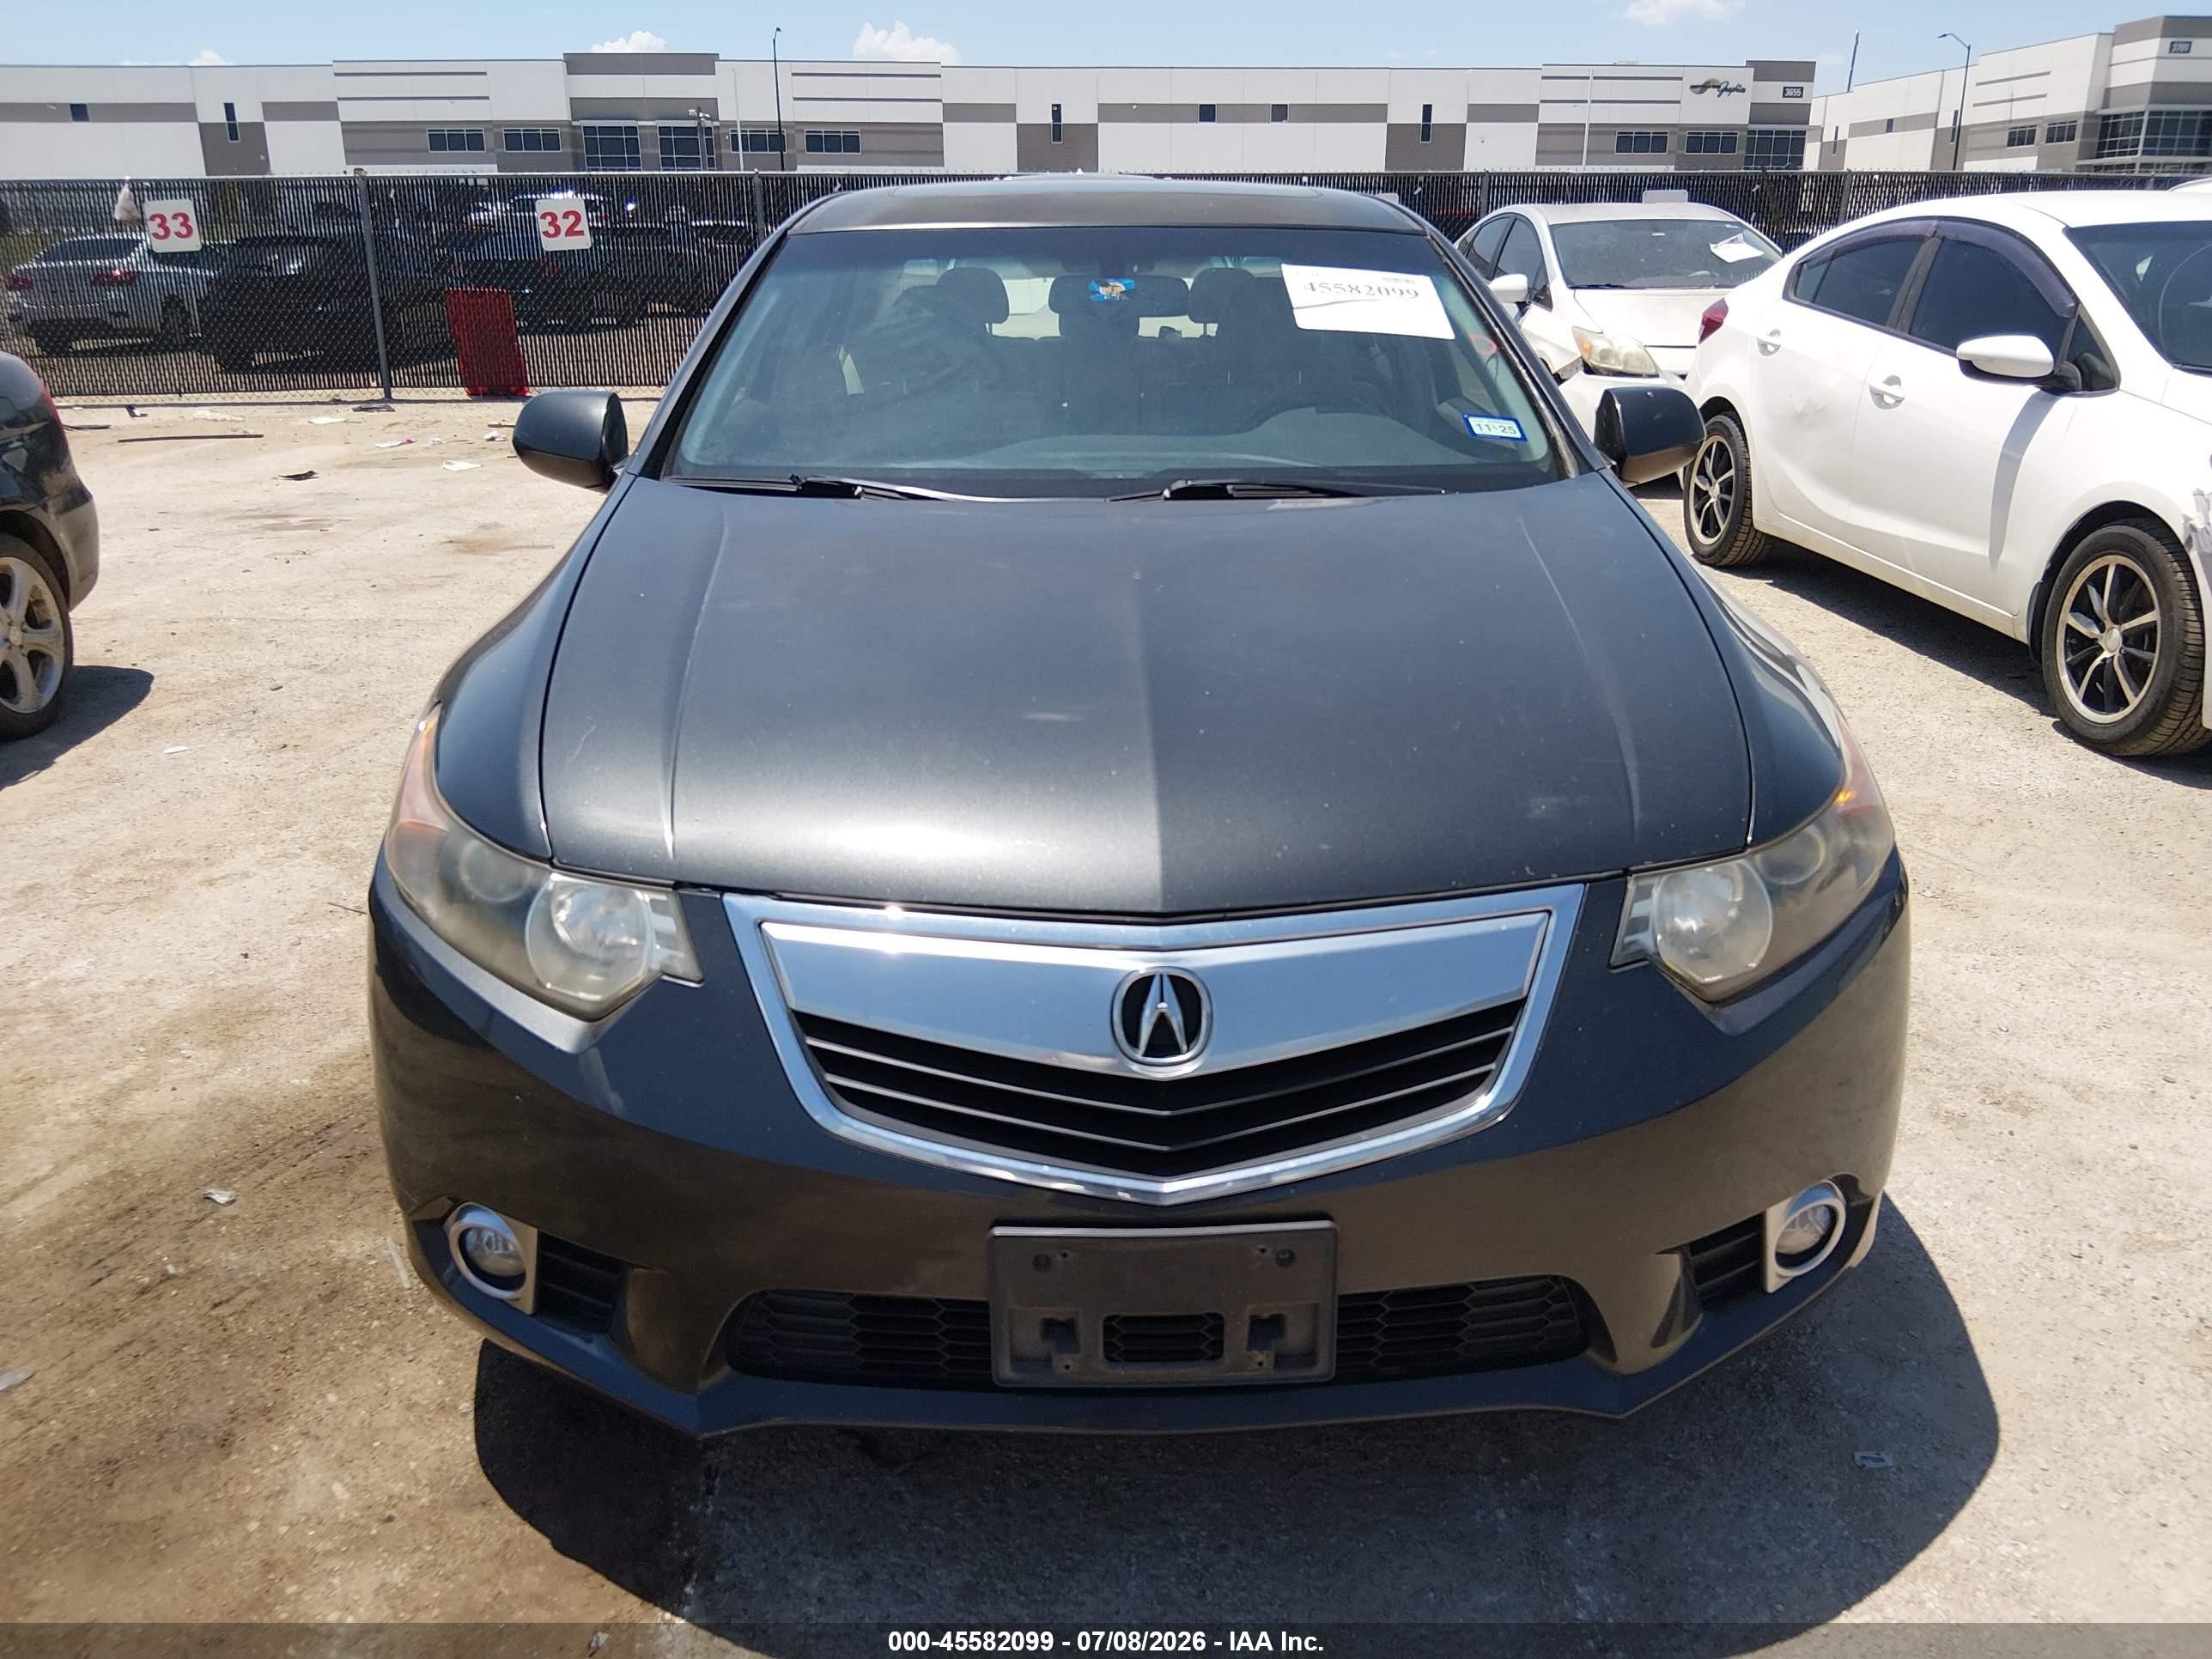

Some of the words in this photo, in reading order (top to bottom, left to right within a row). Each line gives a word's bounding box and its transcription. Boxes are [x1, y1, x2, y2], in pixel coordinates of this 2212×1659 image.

[1784, 88, 1802, 97] 3655
[149, 211, 194, 240] 33
[539, 210, 586, 239] 32
[1304, 282, 1419, 299] 45582099
